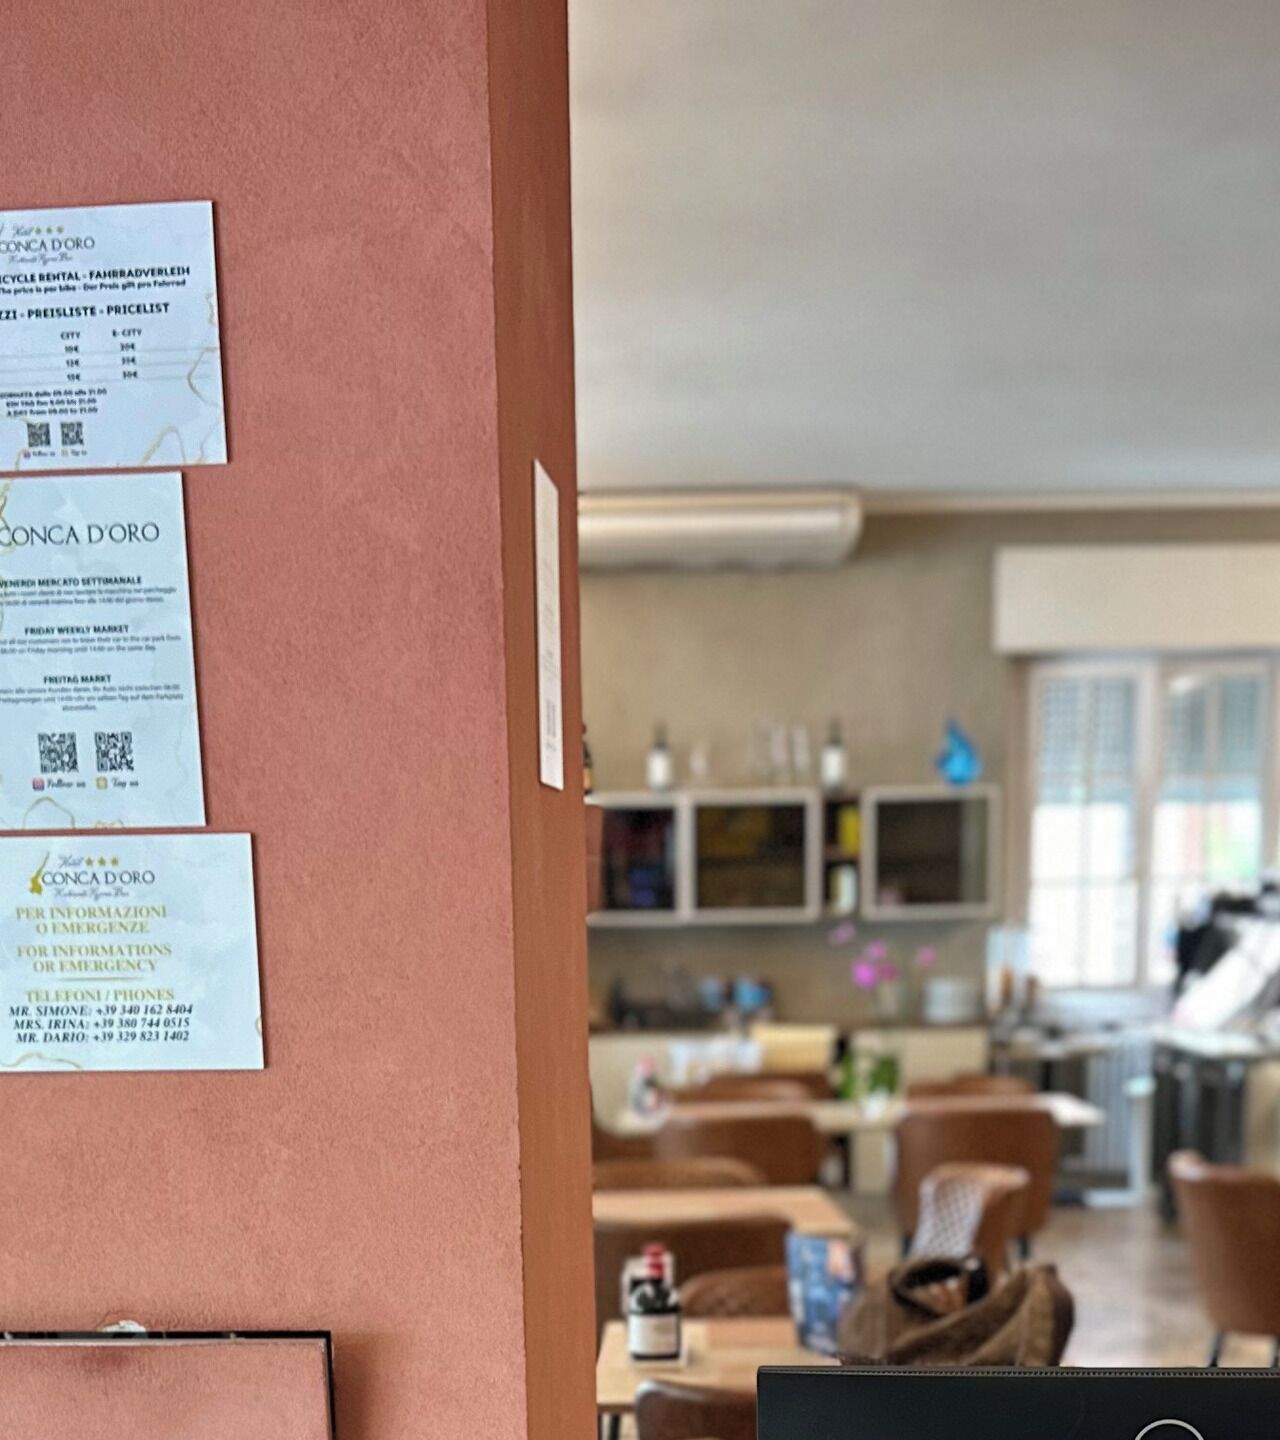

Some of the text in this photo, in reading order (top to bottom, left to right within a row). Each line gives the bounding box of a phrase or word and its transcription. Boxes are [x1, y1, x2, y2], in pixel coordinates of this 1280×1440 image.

[51, 236, 95, 251] D'ORO
[39, 271, 81, 283] RENTAL
[89, 266, 191, 280] FAHRRADVERLEIH
[28, 306, 97, 319] PREISLISTE
[107, 302, 170, 316] PRICELIST
[60, 328, 142, 341] CITY CITY
[87, 521, 160, 545] D'ORO
[38, 577, 79, 587] MERCATO
[81, 575, 142, 586] SETTIMANALE
[24, 624, 129, 636] FRIDAY WEEKLY MARKET
[43, 674, 111, 685] FREITAG MARKT
[41, 869, 156, 886] CONCA D'ORO
[16, 904, 167, 920] PER INFORMAZIONI
[36, 921, 150, 935] O EMERGENZE
[16, 943, 172, 958] FOR INFORMATIONS
[32, 958, 158, 973] OR EMERGENCY
[26, 988, 175, 1003] TELEFONI PHONES
[9, 1003, 193, 1017] MR. SIMONE: +39 340 162 8404
[13, 1016, 190, 1030] MRS. IRINA: +39 380 744 0515
[16, 1029, 190, 1043] MR. DARIO: +39 329 823 1402
